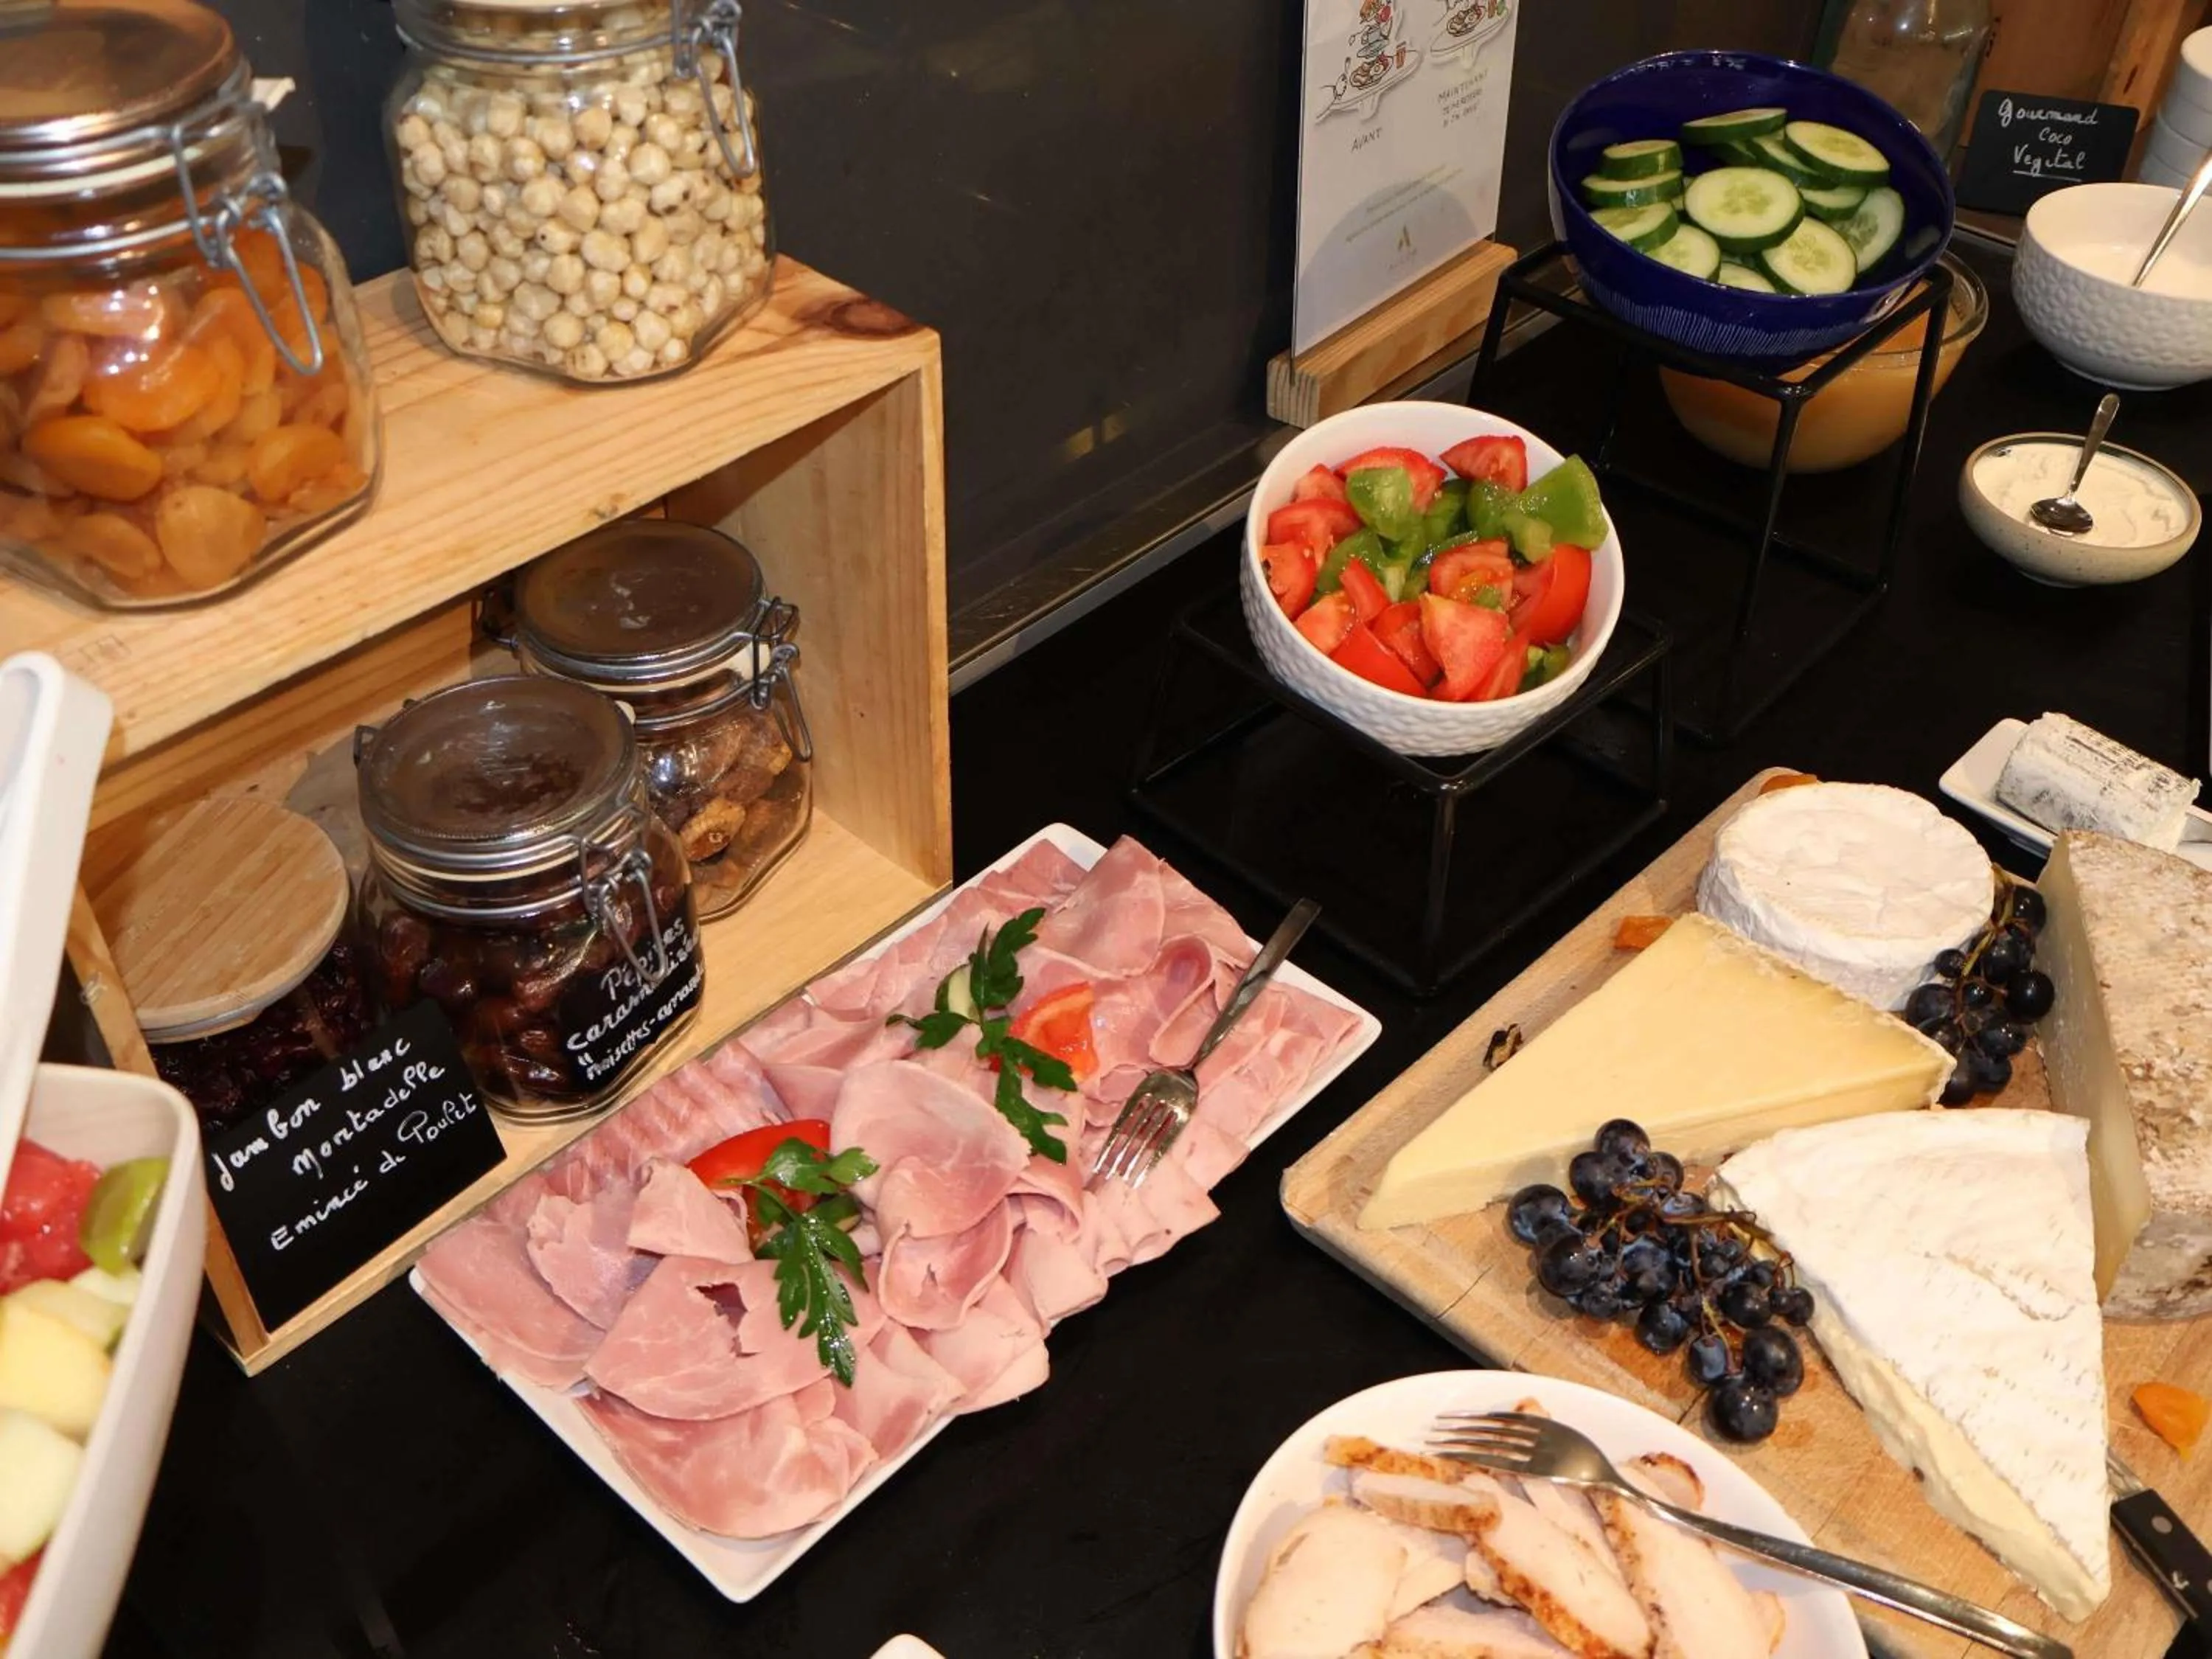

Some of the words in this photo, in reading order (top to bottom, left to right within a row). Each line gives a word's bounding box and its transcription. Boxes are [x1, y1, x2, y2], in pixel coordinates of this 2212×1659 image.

[1997, 97, 2098, 127] Gourmand
[1351, 128, 1382, 151] AVANT
[2039, 126, 2073, 145] Coco
[599, 917, 685, 1001] Pépies
[339, 1037, 411, 1092] blanc
[292, 1061, 445, 1179] Mortadelle
[378, 1150, 406, 1174] de
